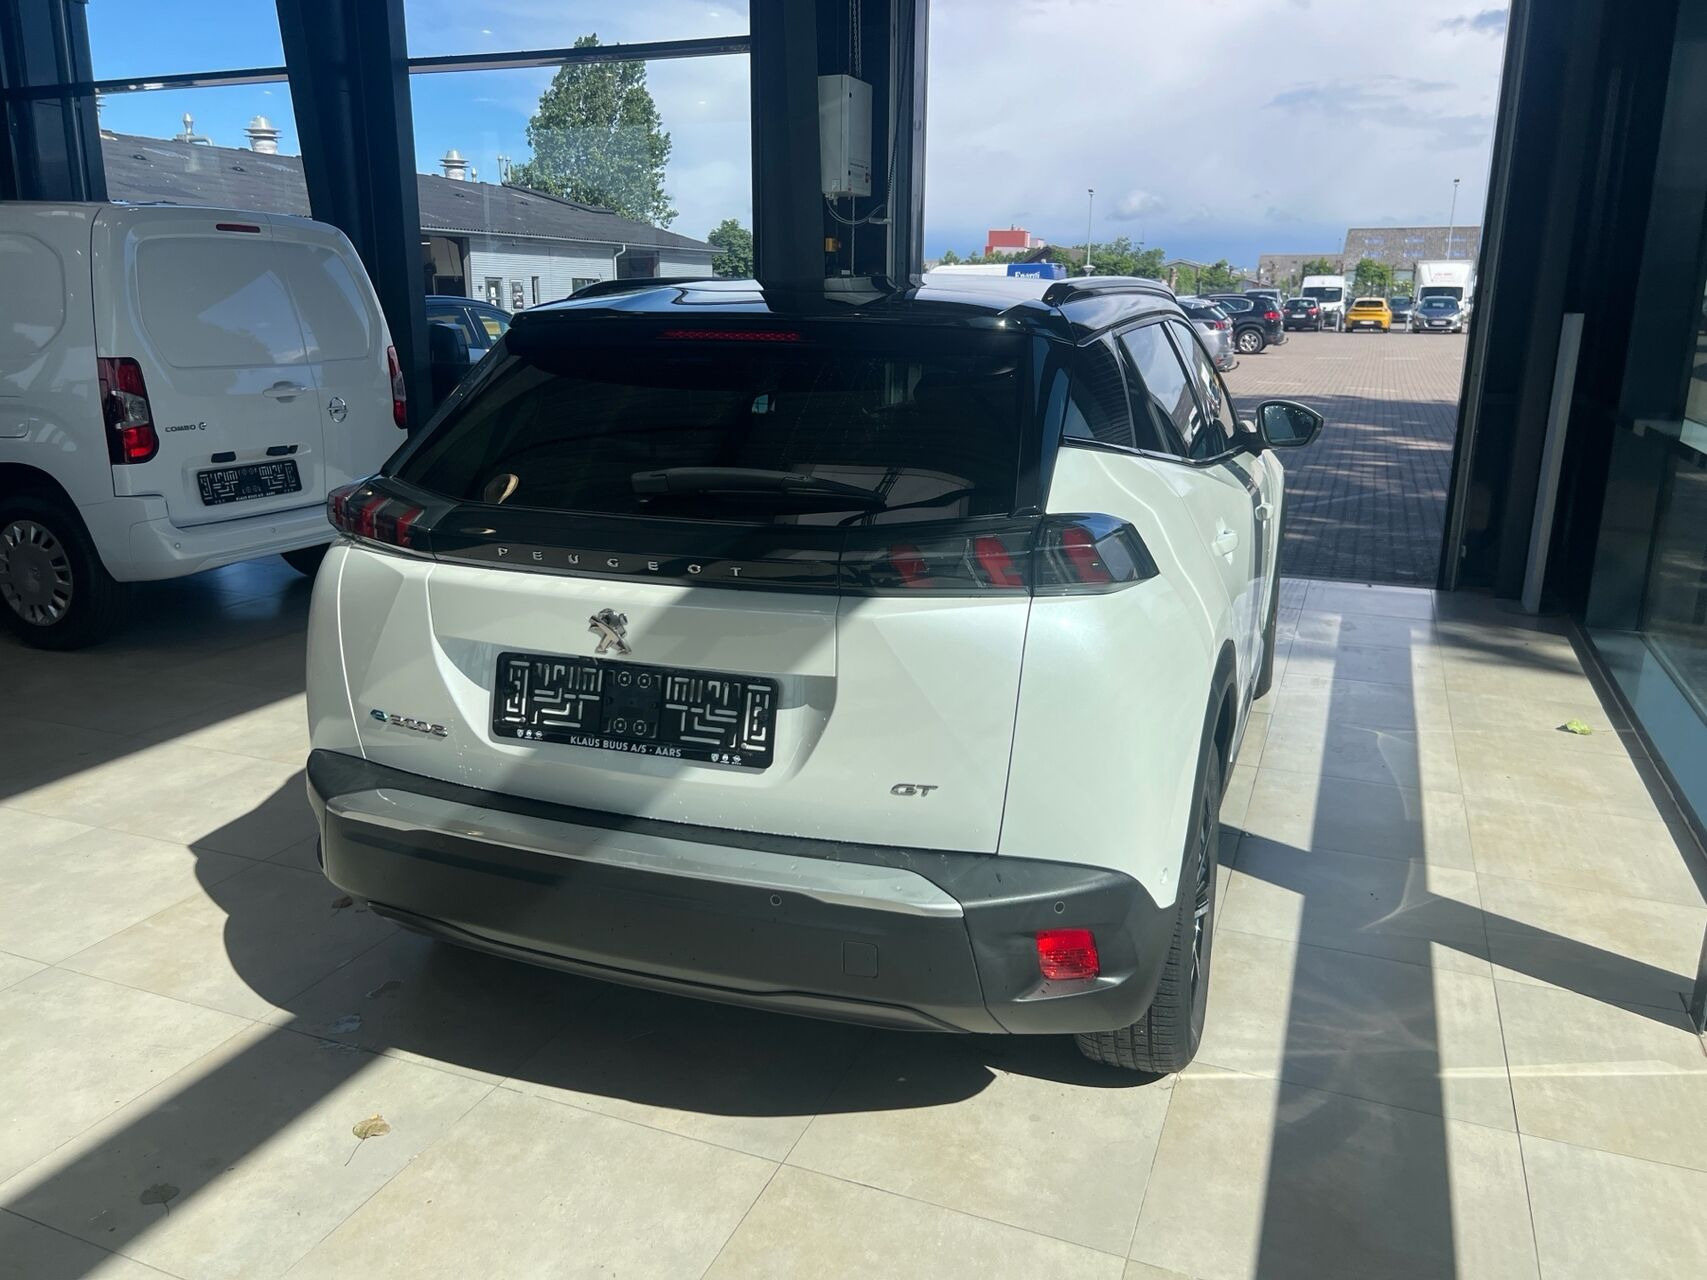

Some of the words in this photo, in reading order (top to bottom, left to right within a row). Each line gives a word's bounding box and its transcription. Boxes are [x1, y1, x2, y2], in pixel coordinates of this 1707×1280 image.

[165, 424, 197, 432] COMBO
[498, 547, 742, 577] PEUGEOT
[570, 735, 600, 748] KLAUS
[602, 740, 629, 752] BUUS
[630, 743, 647, 754] A/S
[655, 747, 682, 758] AARS
[890, 783, 939, 798] GT
